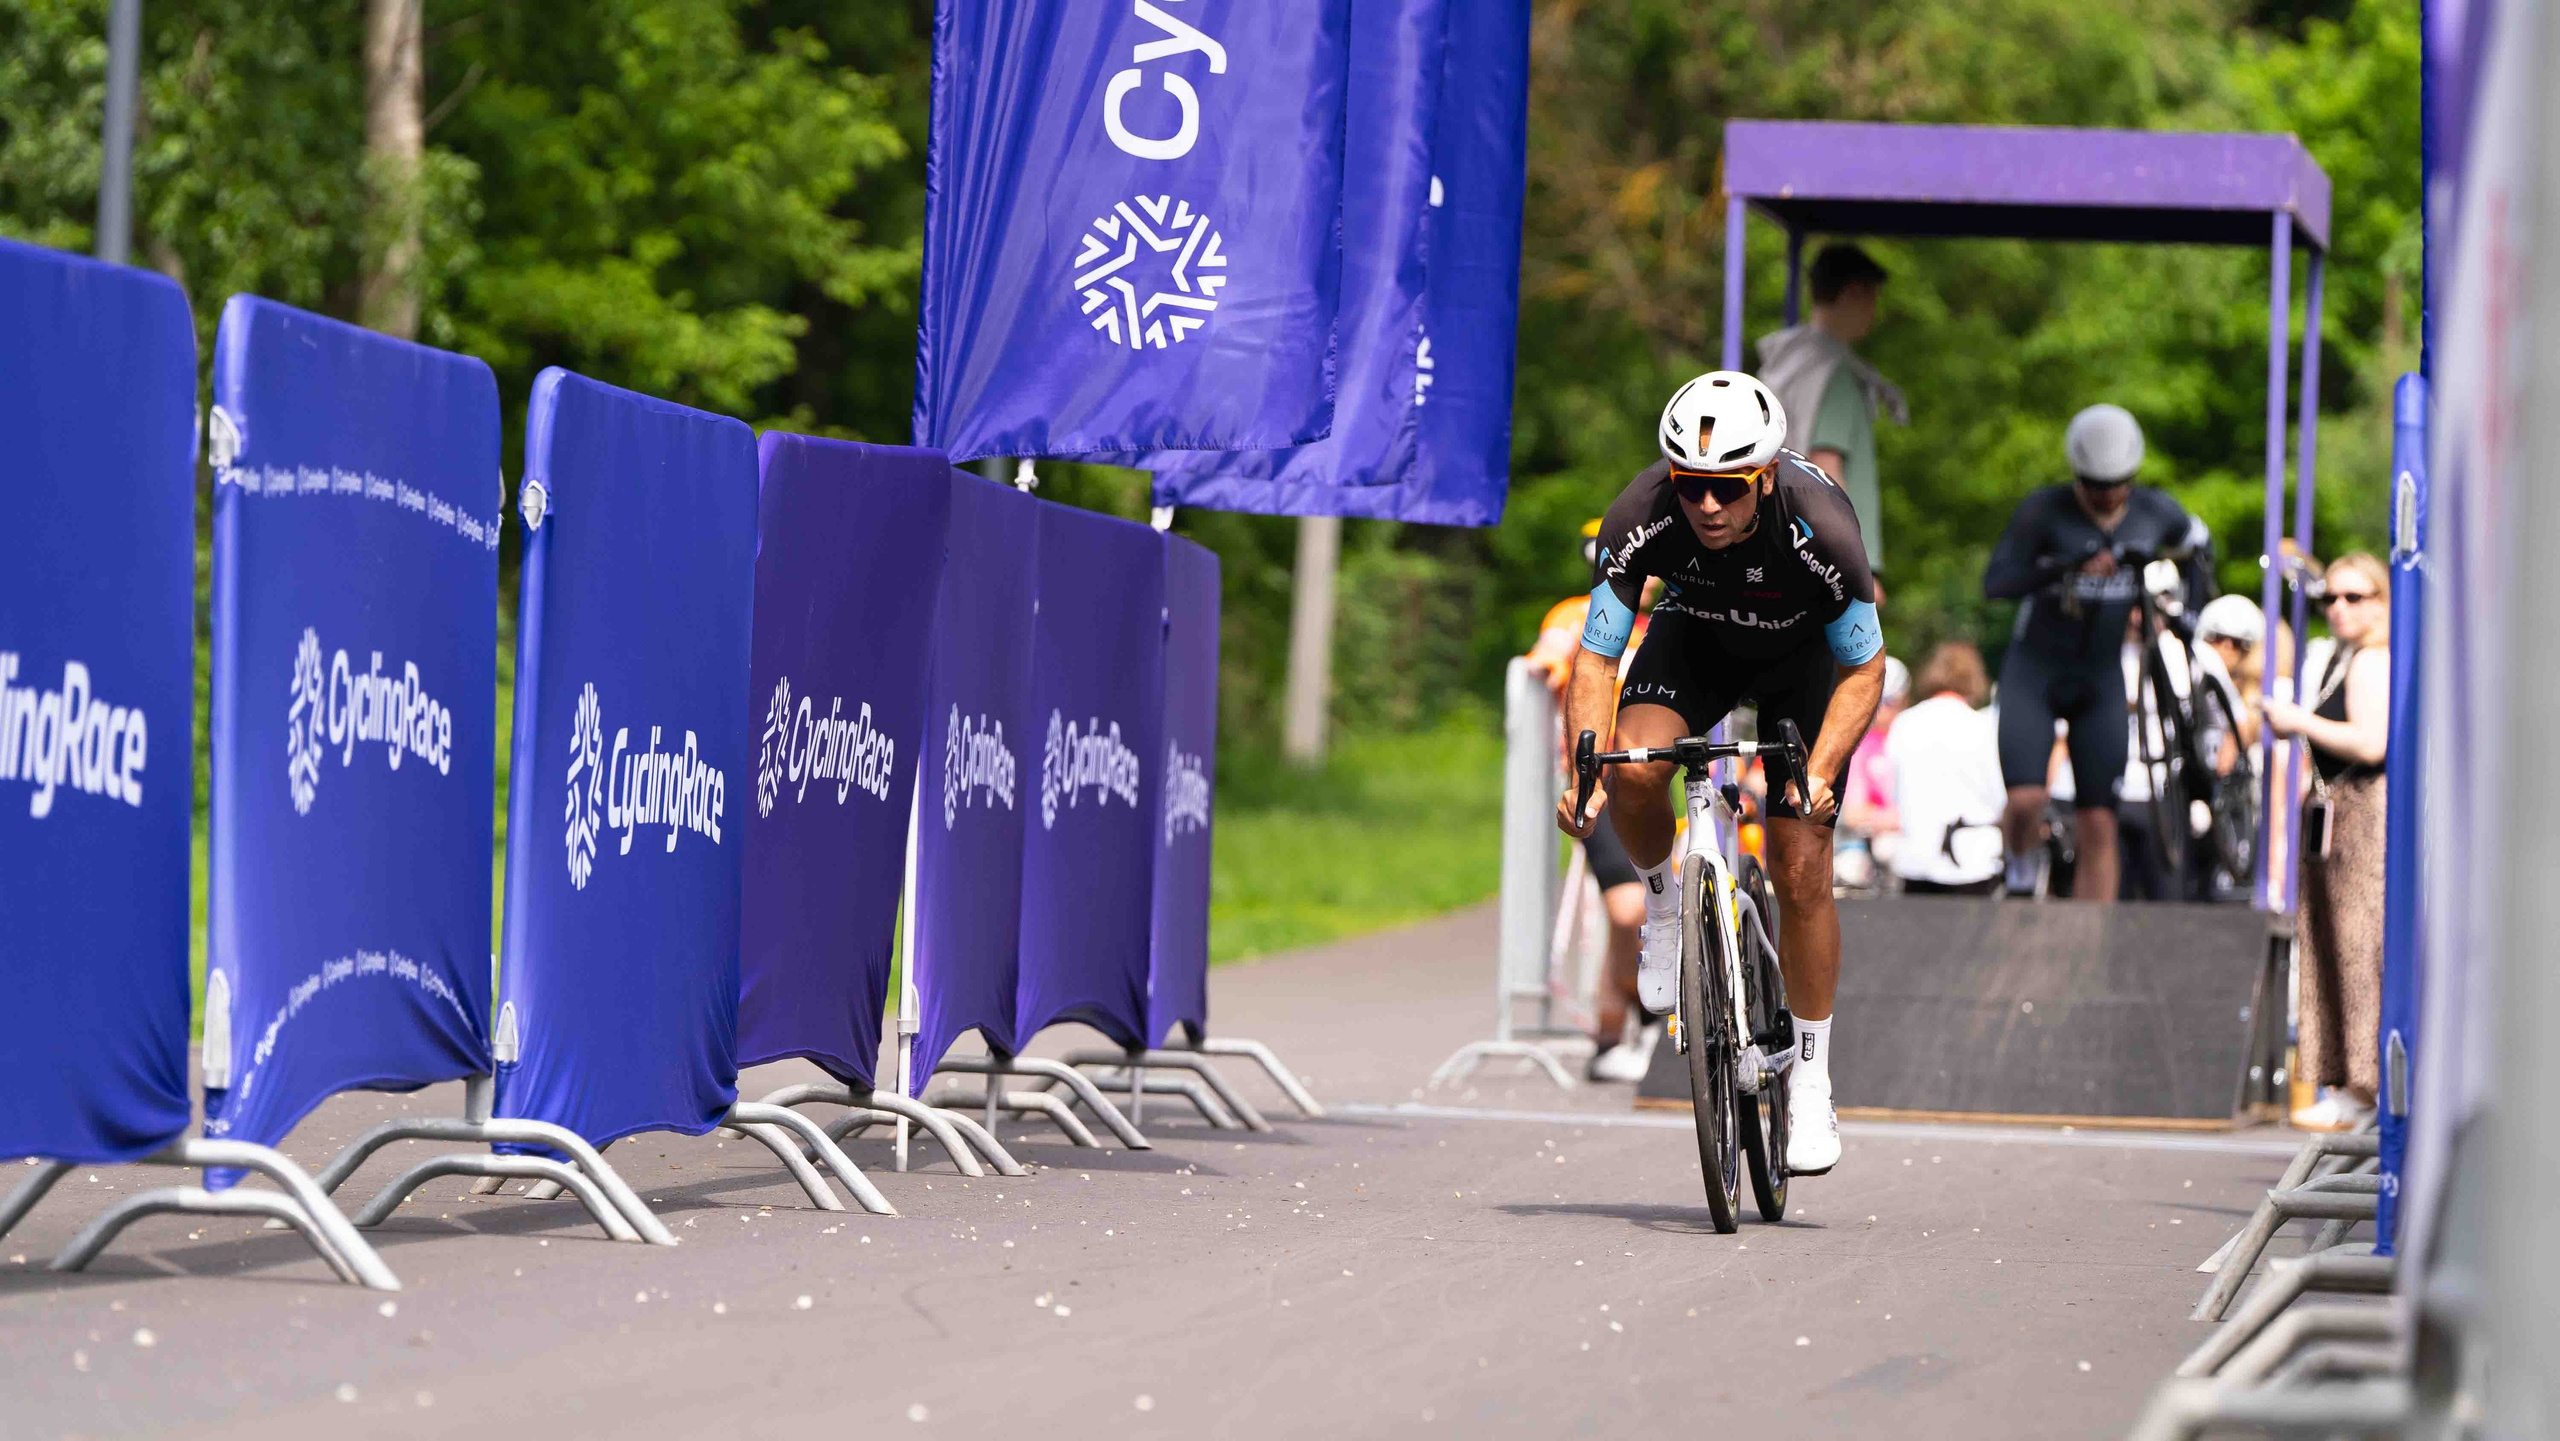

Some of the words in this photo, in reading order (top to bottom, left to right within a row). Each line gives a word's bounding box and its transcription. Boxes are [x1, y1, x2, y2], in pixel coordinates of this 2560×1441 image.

[1104, 0, 1227, 161] Cy
[1672, 572, 1716, 588] AURUM
[1835, 629, 1878, 653] AURUM
[0, 651, 148, 819] lingRace
[329, 649, 452, 776] CyclingRace
[789, 696, 895, 805] CyclingRace
[608, 725, 725, 856] CyclingRace
